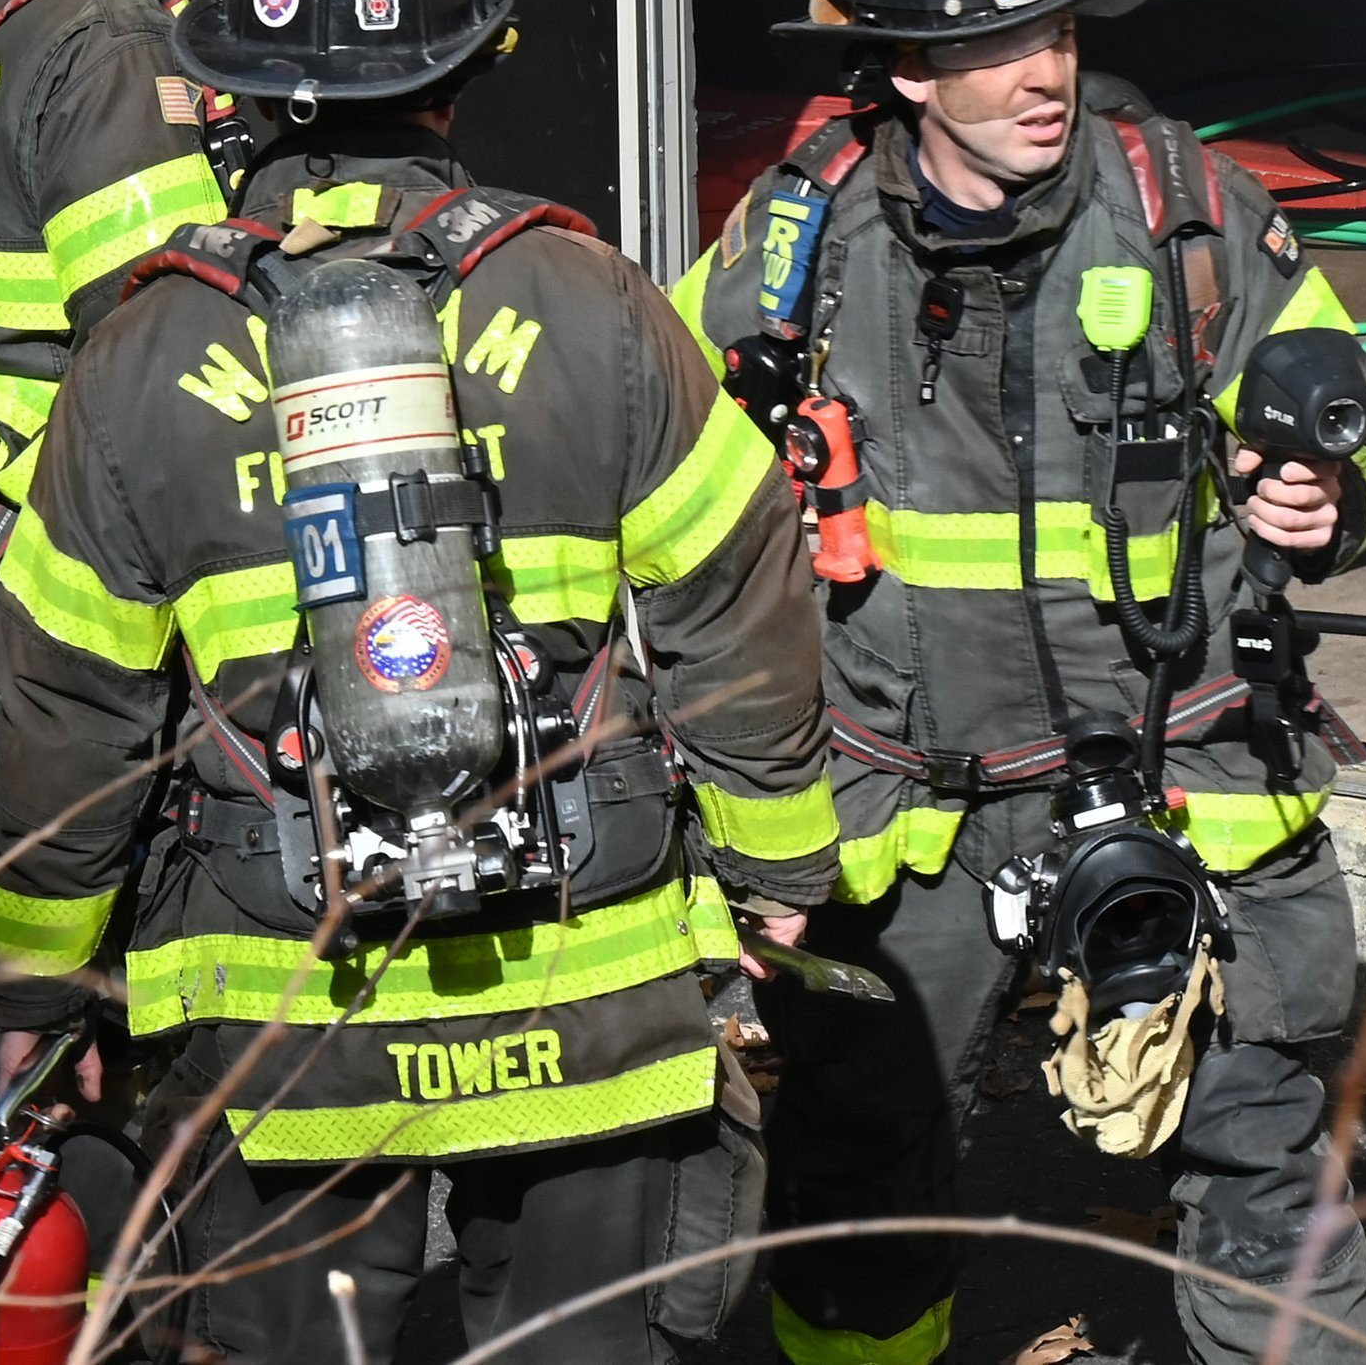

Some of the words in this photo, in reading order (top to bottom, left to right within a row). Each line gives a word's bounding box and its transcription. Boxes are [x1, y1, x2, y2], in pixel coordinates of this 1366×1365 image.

[437, 199, 501, 243] 3M
[310, 396, 387, 426] SCOTT
[1272, 408, 1296, 427] FLIR
[295, 518, 347, 580] 01
[387, 1029, 563, 1100] TOWER
